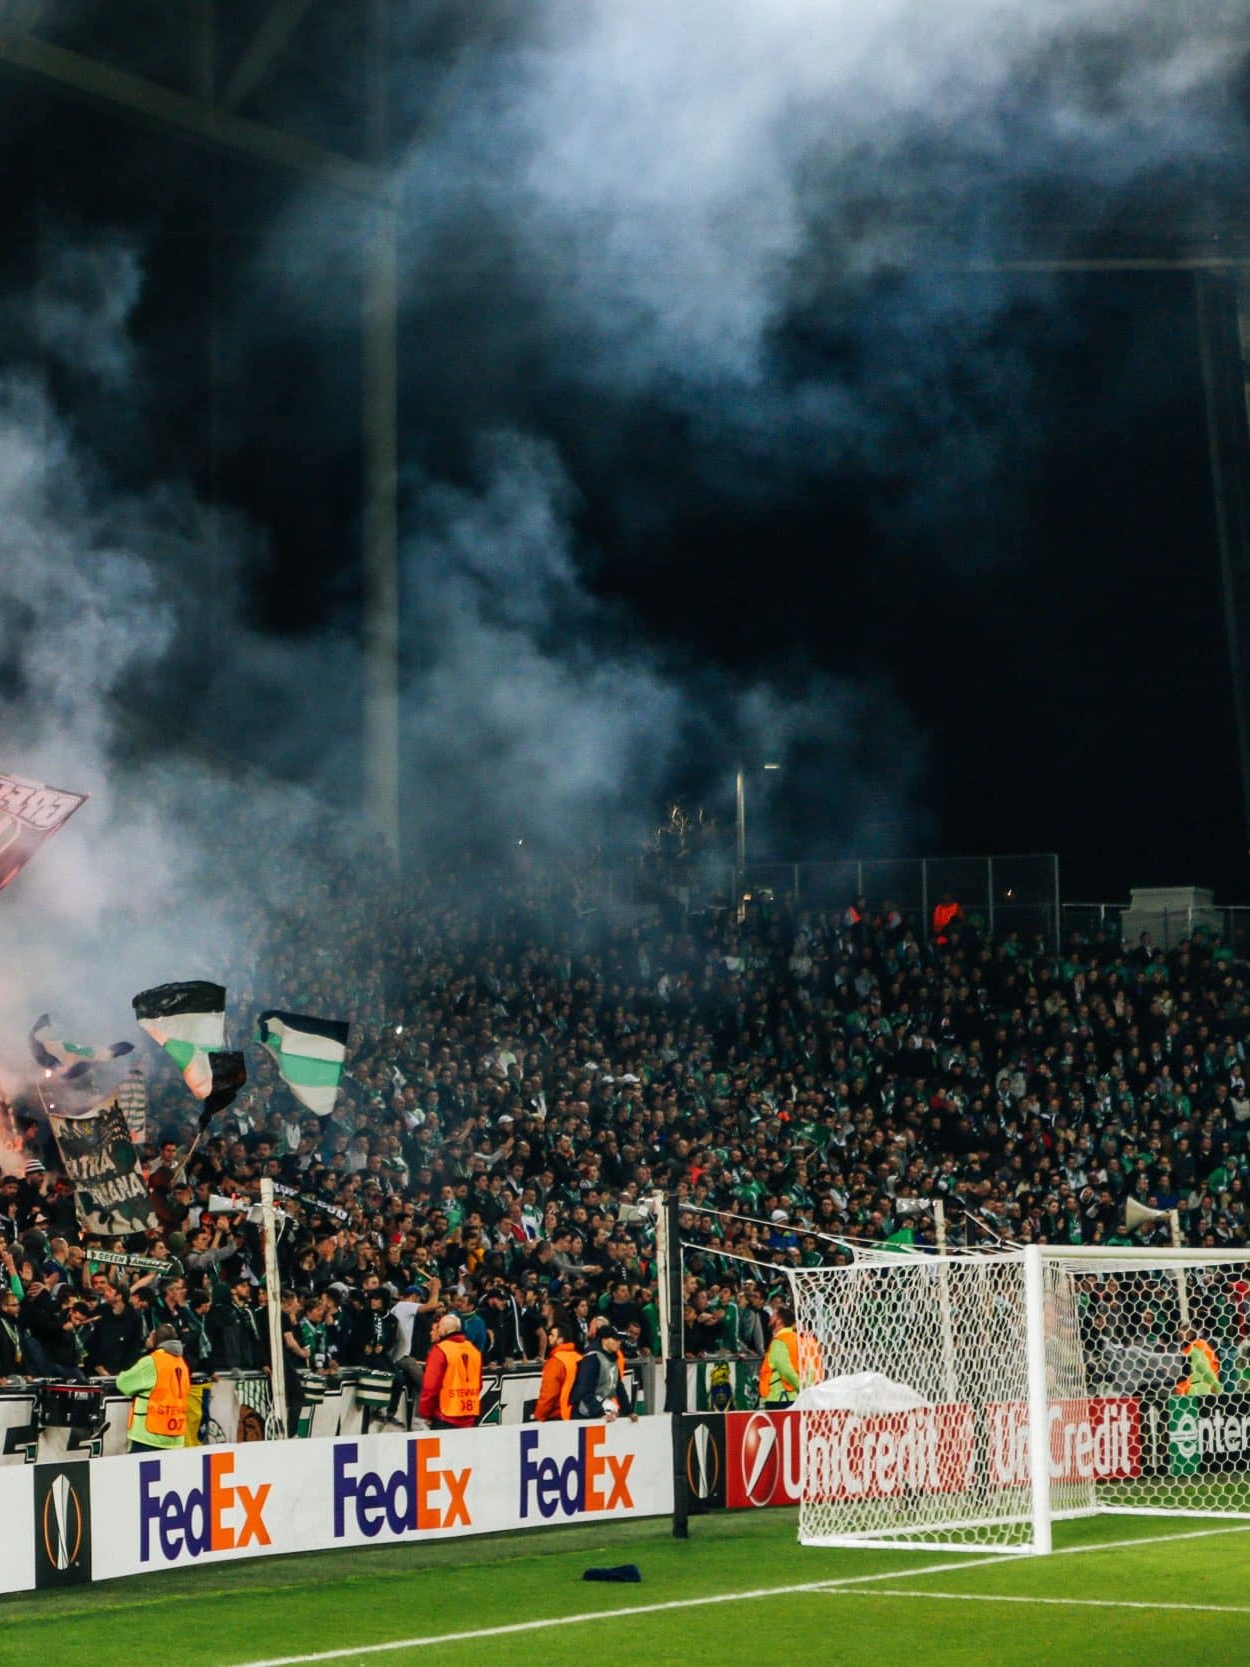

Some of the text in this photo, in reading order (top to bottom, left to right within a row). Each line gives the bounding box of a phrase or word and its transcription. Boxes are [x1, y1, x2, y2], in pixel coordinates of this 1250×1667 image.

[334, 1438, 472, 1537] FedEx
[520, 1426, 634, 1518] FedEx
[783, 1412, 940, 1499] UniCredit
[995, 1404, 1131, 1482] UnCredit
[139, 1452, 272, 1562] FedEx
